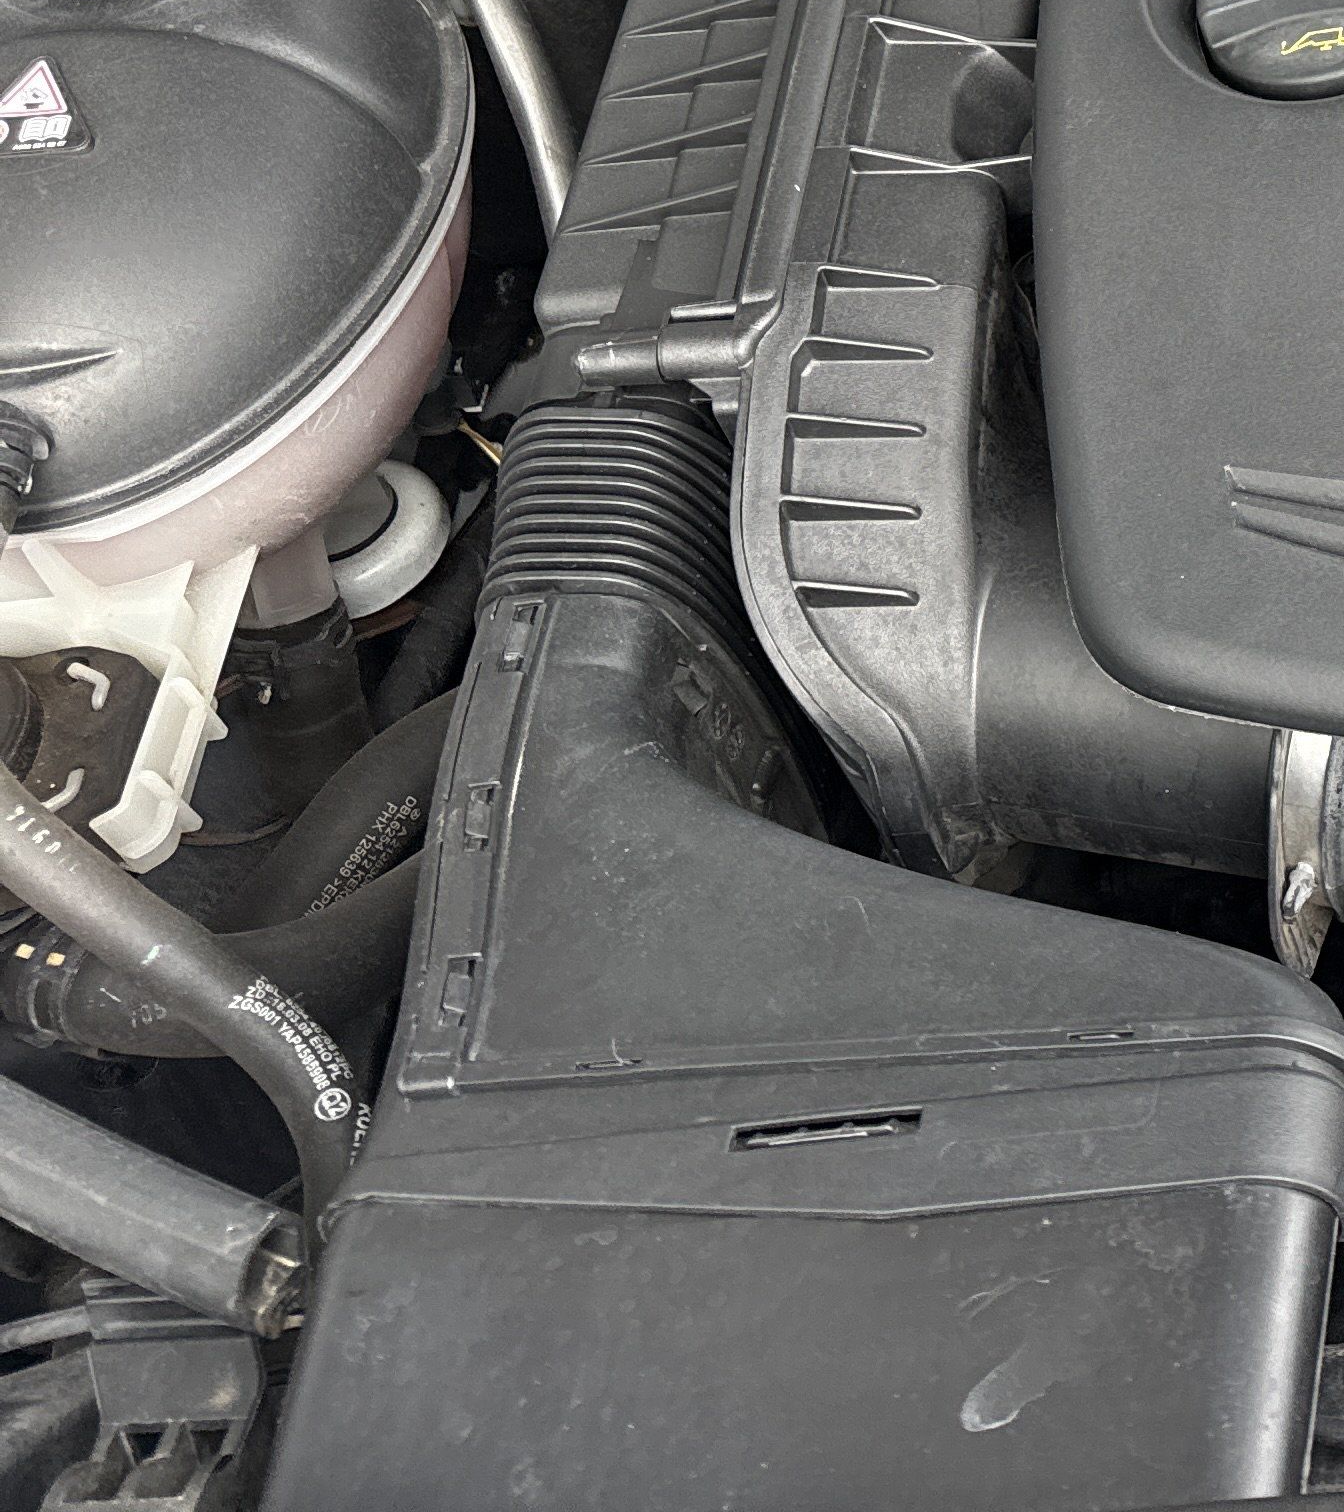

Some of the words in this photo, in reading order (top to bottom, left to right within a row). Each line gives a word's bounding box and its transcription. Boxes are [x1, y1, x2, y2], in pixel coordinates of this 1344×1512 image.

[372, 802, 398, 833] PHX
[340, 834, 376, 877] 125639
[228, 995, 282, 1026] ZGS001
[309, 1033, 333, 1061] EHO
[326, 1063, 342, 1081] PL
